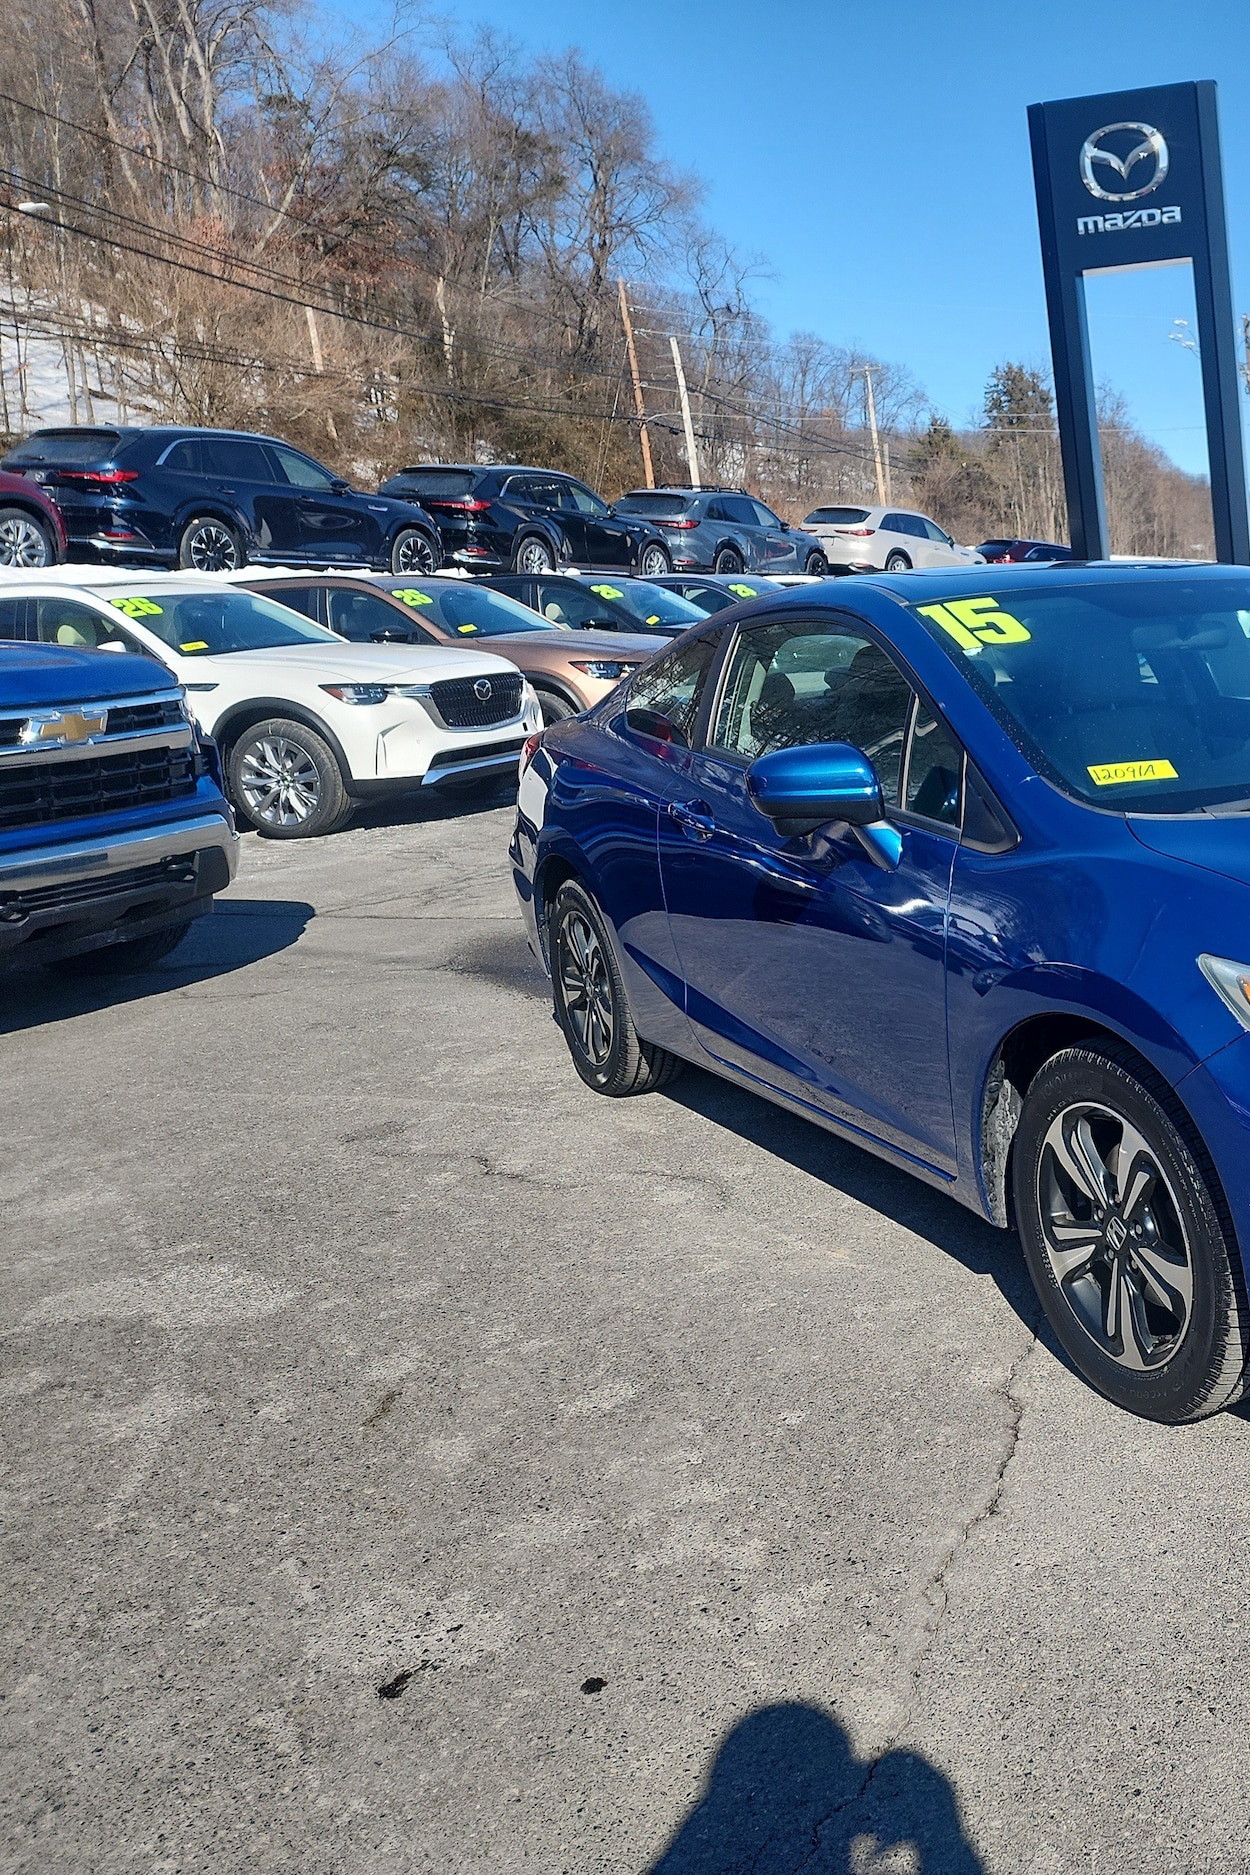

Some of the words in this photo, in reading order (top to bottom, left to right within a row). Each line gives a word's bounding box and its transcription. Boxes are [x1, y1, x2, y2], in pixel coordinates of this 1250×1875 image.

[1076, 205, 1182, 235] mazda
[110, 597, 164, 618] 26
[391, 588, 434, 607] 26
[916, 596, 1032, 650] 15
[1093, 764, 1156, 782] 12091A
